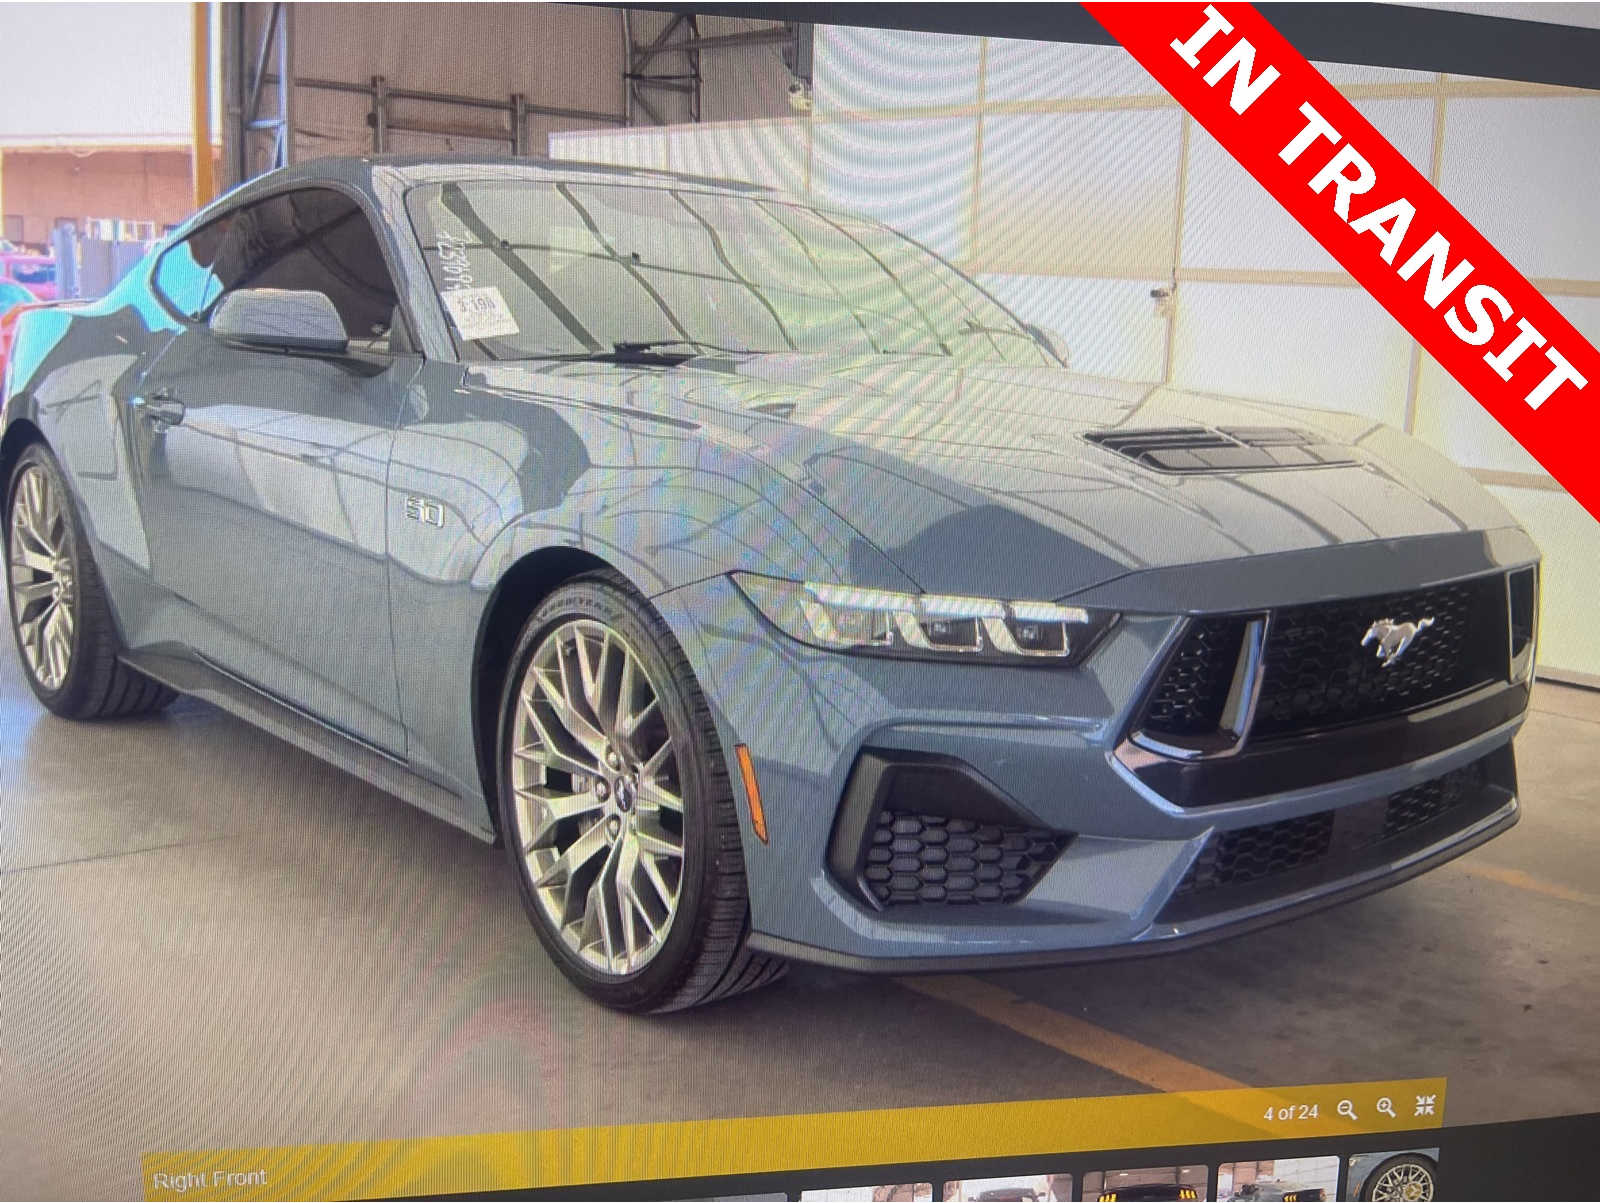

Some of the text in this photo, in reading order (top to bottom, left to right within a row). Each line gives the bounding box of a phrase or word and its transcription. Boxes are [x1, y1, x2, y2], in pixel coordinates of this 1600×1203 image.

[1263, 1104, 1319, 1121] 4 of 24
[153, 1168, 268, 1193] Right Front
